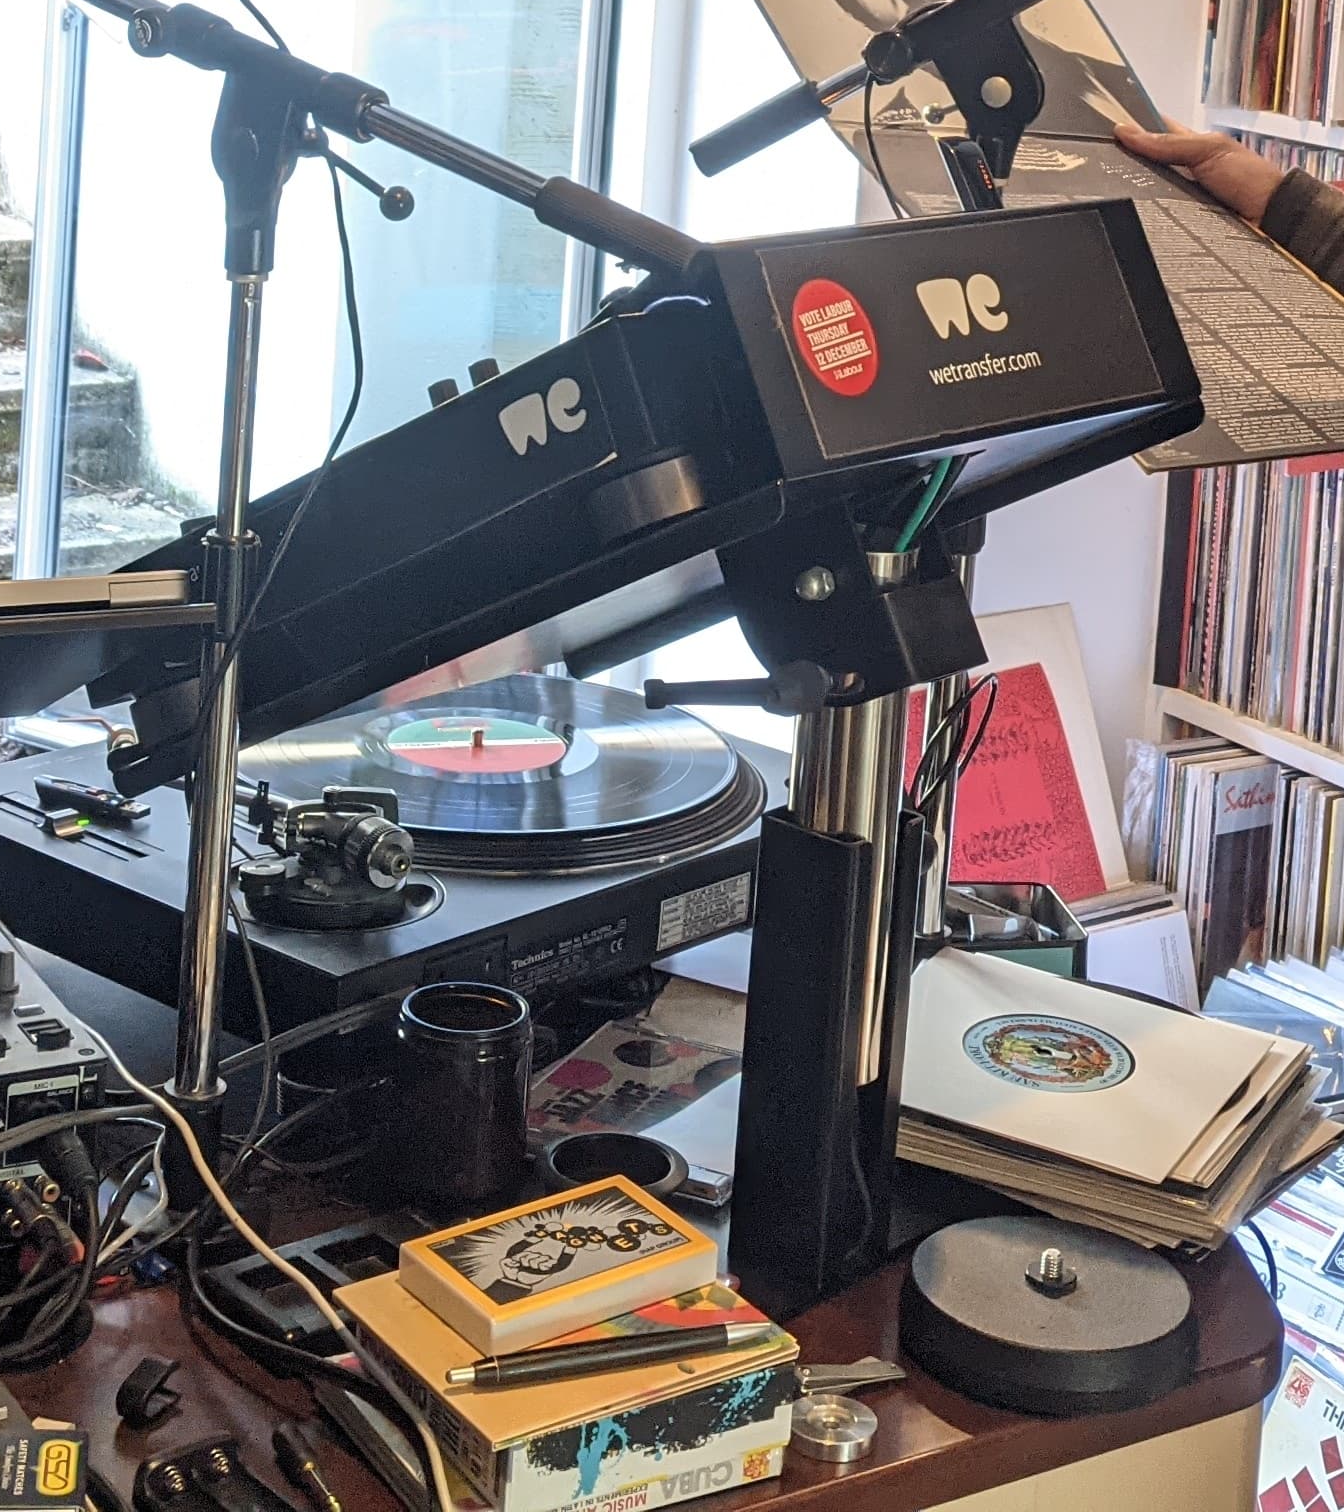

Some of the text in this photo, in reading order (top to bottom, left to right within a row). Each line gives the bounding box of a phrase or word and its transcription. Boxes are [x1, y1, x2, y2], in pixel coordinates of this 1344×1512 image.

[798, 299, 854, 327] VOTE LABOUR
[806, 322, 849, 346] THURSDAY
[815, 338, 869, 366] 12 DECEMBER
[928, 347, 1041, 385] wetransfer.com
[511, 949, 554, 970] Technics
[14, 1439, 29, 1496] SAFETY MATCHES
[659, 1461, 733, 1501] CUBA
[600, 1491, 648, 1512] MUSIC
